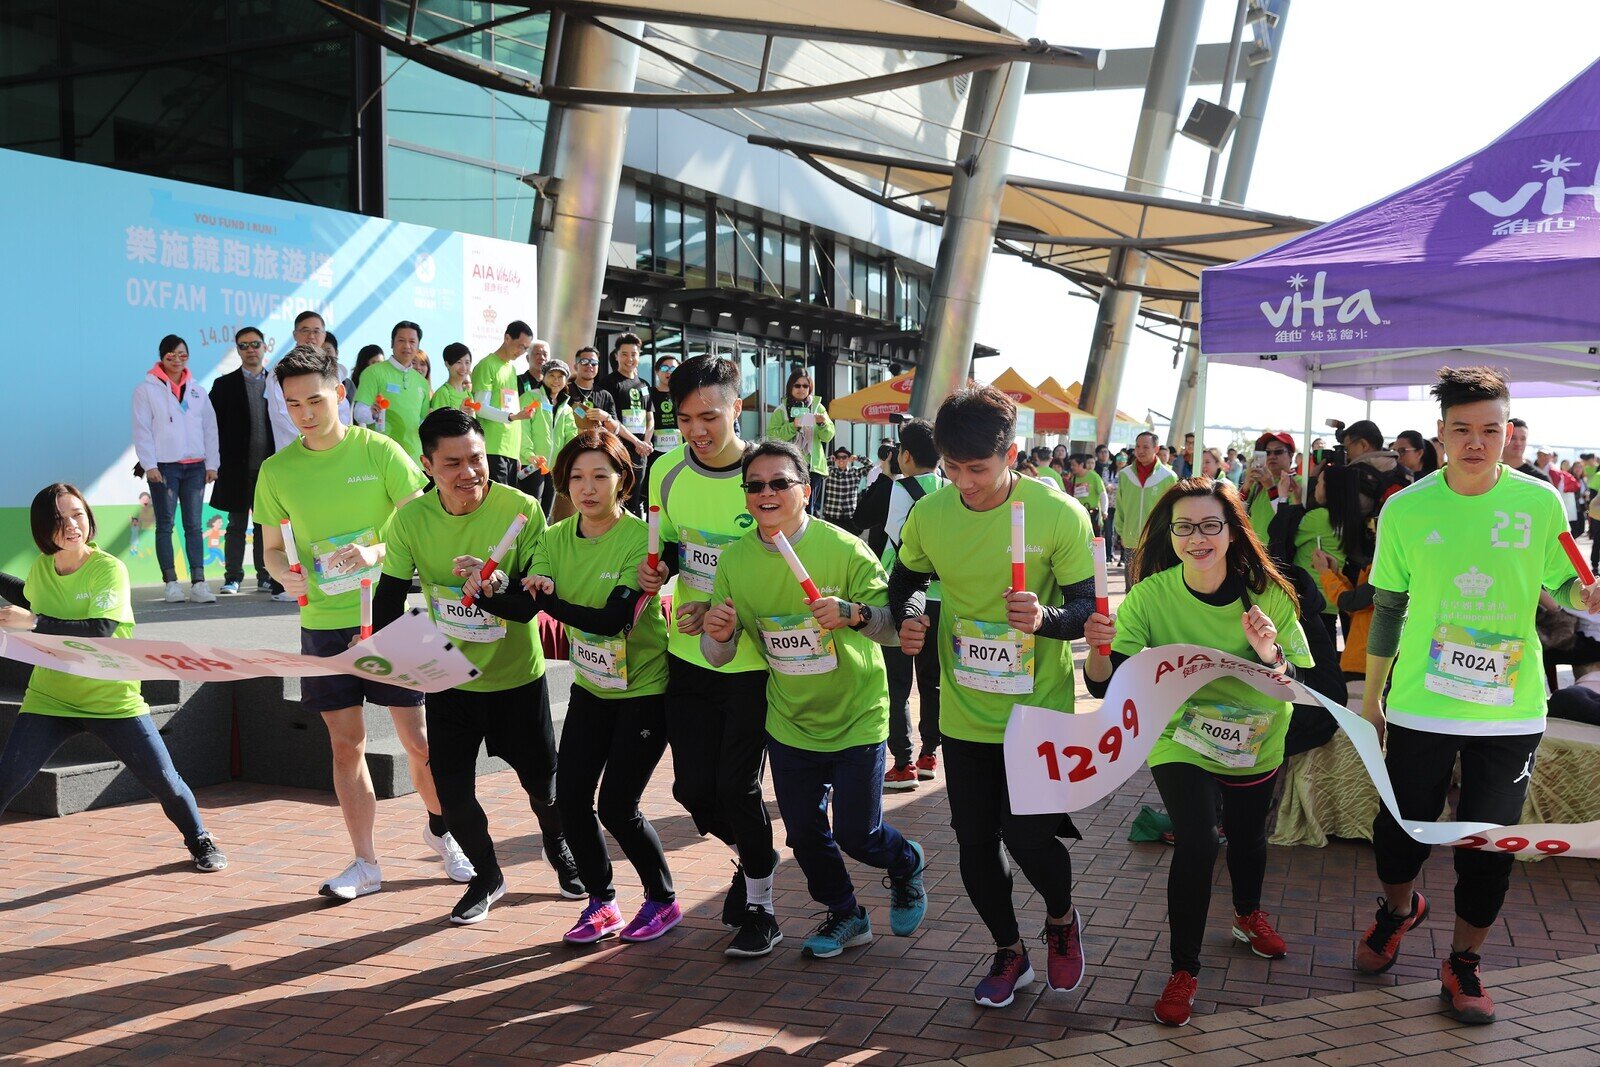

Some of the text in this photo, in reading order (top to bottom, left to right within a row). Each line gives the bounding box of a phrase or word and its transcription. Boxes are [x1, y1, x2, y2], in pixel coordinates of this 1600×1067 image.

[194, 213, 216, 226] YOU
[219, 217, 245, 230] FUND
[472, 264, 495, 280] AIA
[126, 278, 207, 313] OXFAM
[1260, 271, 1381, 328] vita
[1491, 511, 1532, 548] 23
[447, 604, 484, 618] R06A
[771, 635, 812, 649] R09A
[145, 654, 234, 671] 1299
[578, 646, 608, 666] R05A
[969, 644, 1010, 662] R07A
[1451, 651, 1496, 673] R02A
[1155, 654, 1213, 685] AIA
[1037, 699, 1140, 783] 1299
[1201, 722, 1241, 742] R08A
